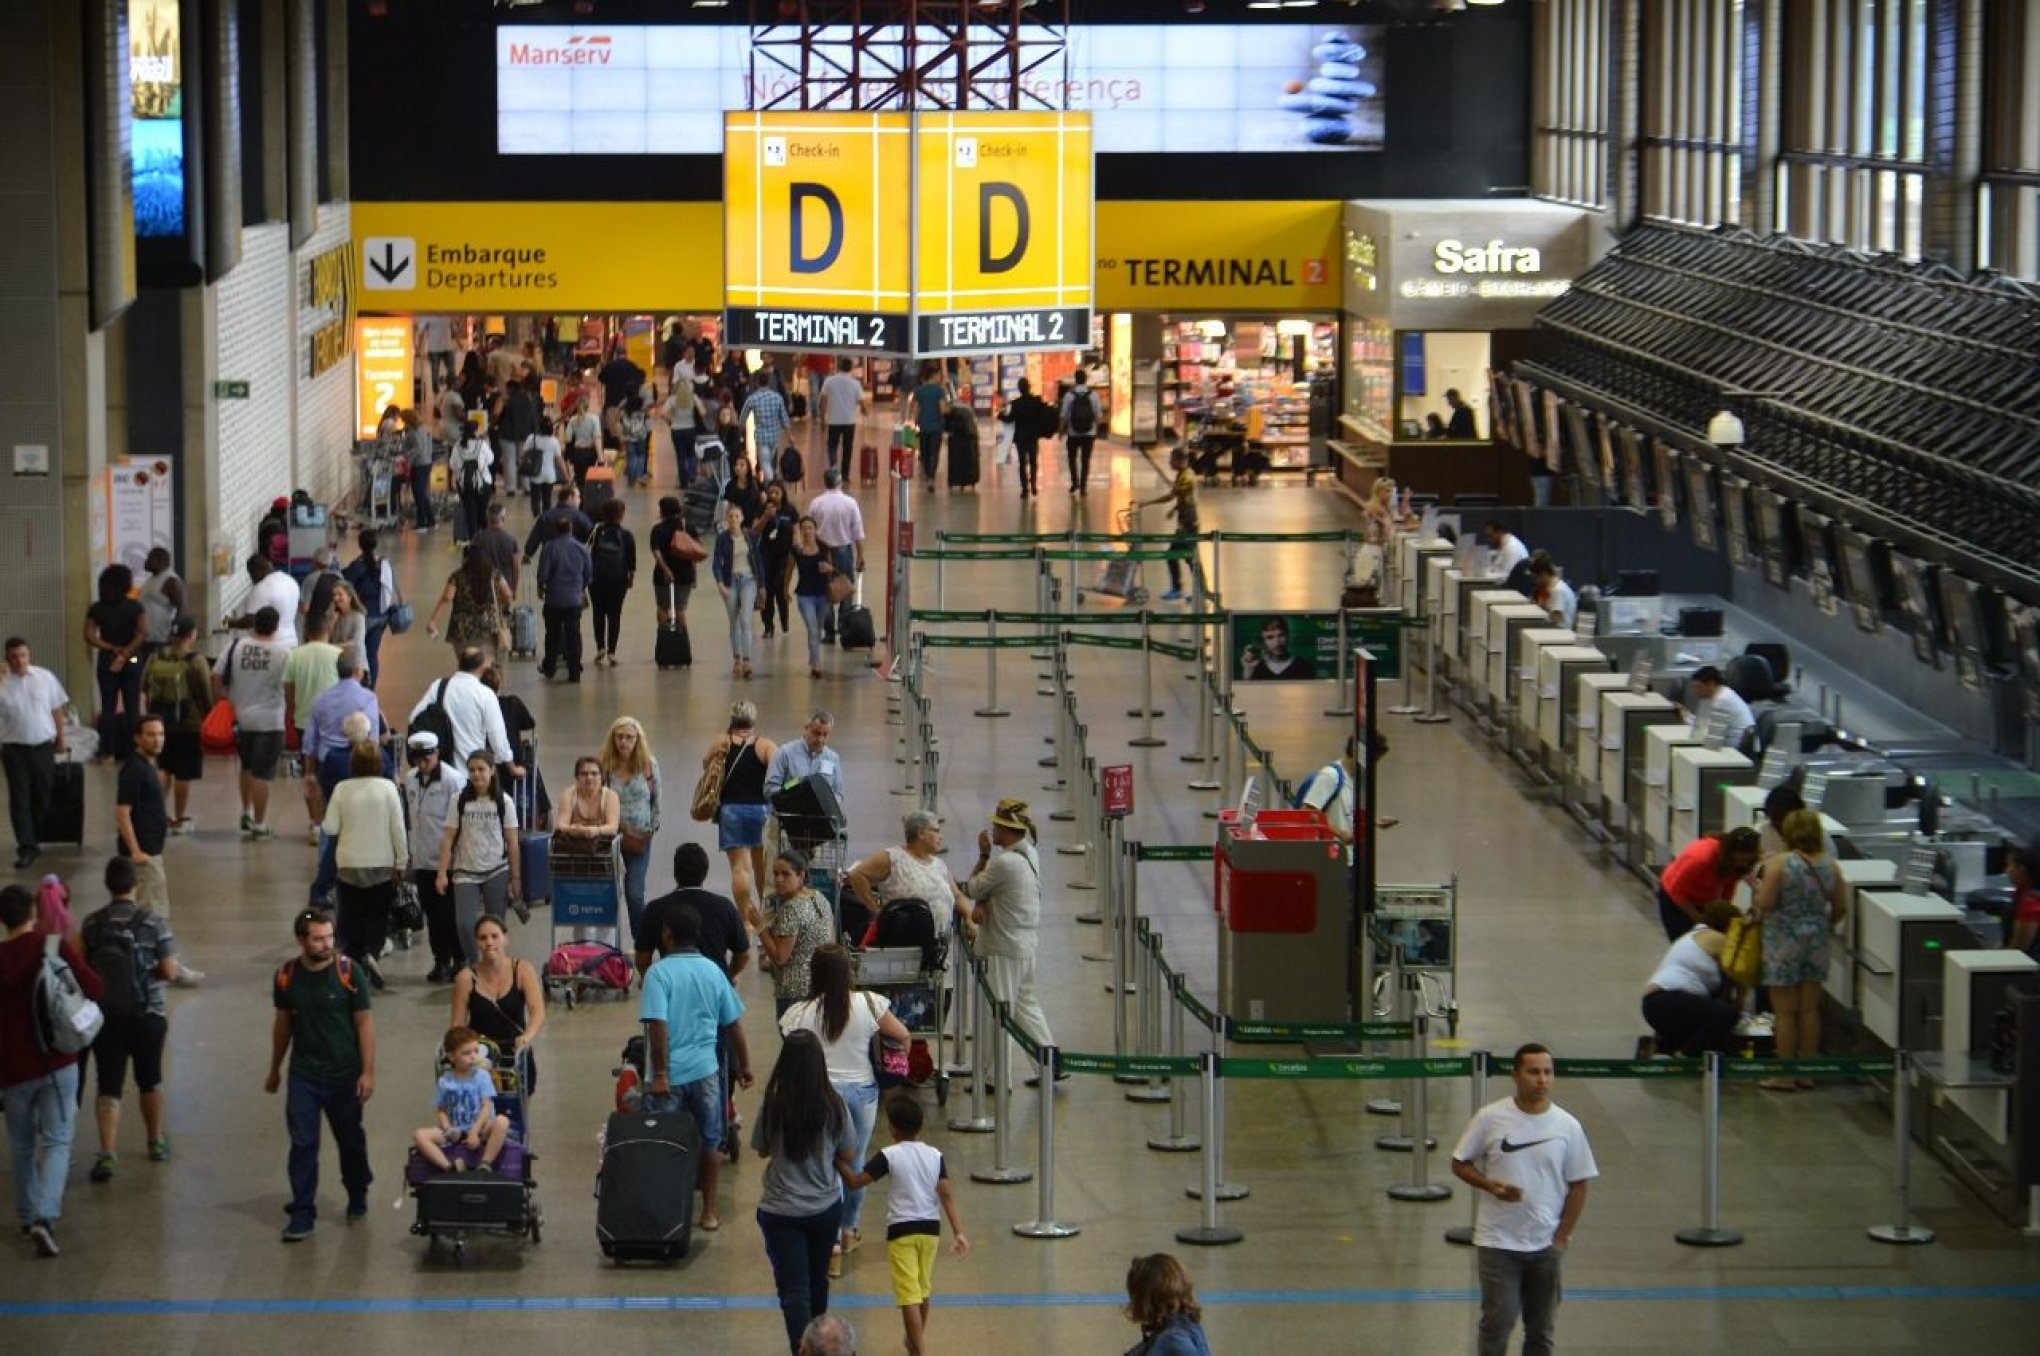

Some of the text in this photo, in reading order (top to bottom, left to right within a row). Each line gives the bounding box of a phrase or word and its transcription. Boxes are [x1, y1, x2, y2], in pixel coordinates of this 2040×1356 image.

[509, 43, 612, 65] Manserv
[788, 143, 840, 158] Check-in
[979, 143, 1028, 158] Check-in
[789, 181, 844, 274] D
[978, 181, 1031, 274] D
[427, 244, 546, 268] Embarque
[1434, 239, 1541, 273] Safra
[427, 269, 558, 293] Departures
[1124, 258, 1294, 286] TERMINAL
[1307, 261, 1322, 283] 2
[755, 312, 885, 346] TERMINAL 2
[939, 312, 1065, 346] TERMINAL 2
